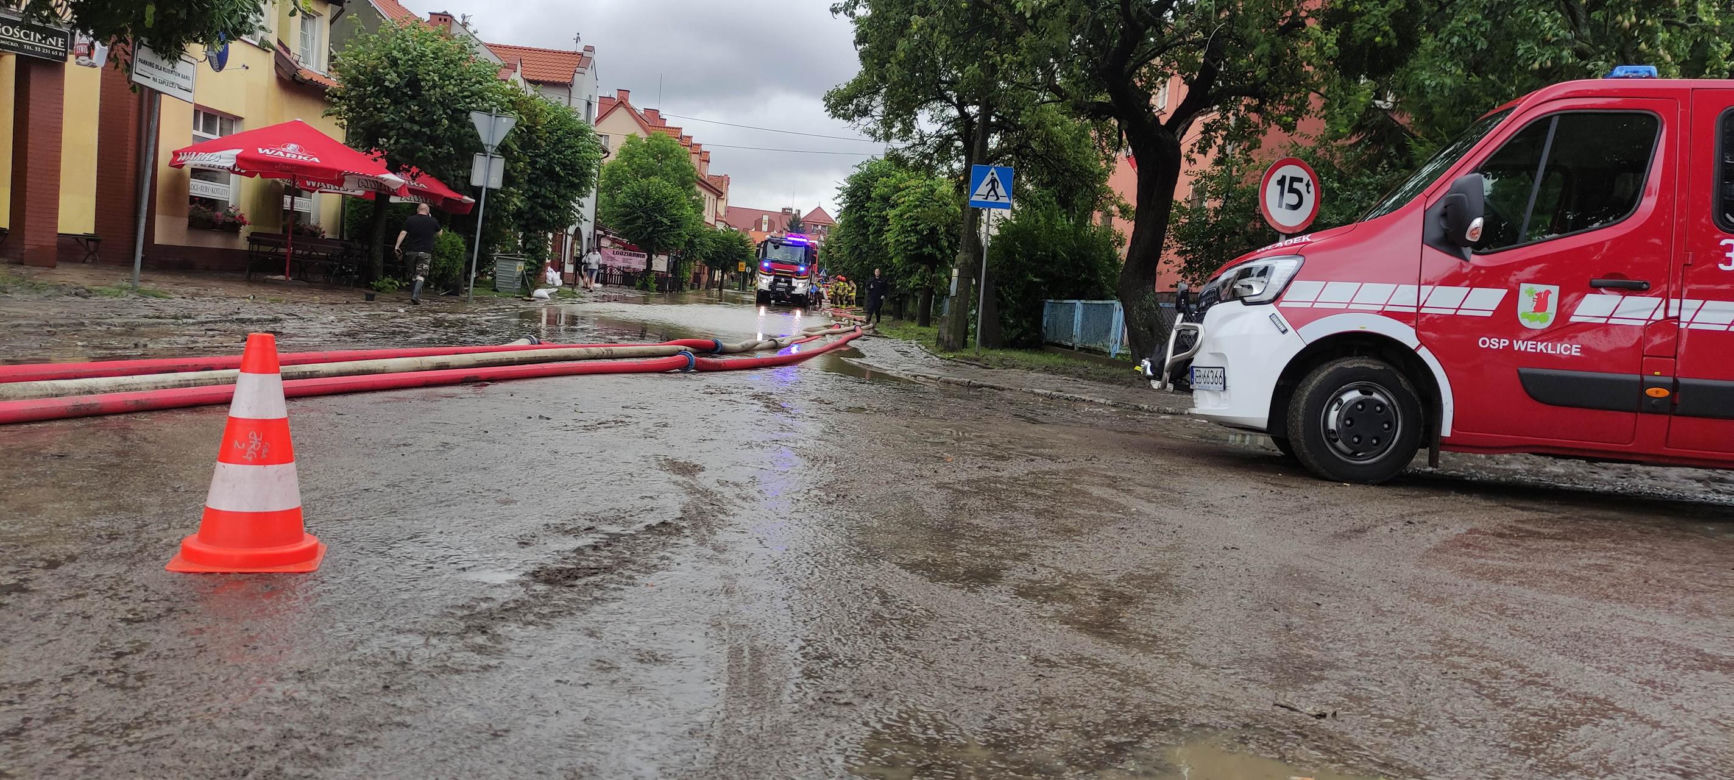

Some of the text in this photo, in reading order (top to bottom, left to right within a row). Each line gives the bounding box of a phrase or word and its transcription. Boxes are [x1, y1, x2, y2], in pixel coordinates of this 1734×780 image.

[0, 24, 65, 48] OŚCINNE
[257, 147, 321, 163] WARKA
[1478, 336, 1582, 356] OSP WEKLICE
